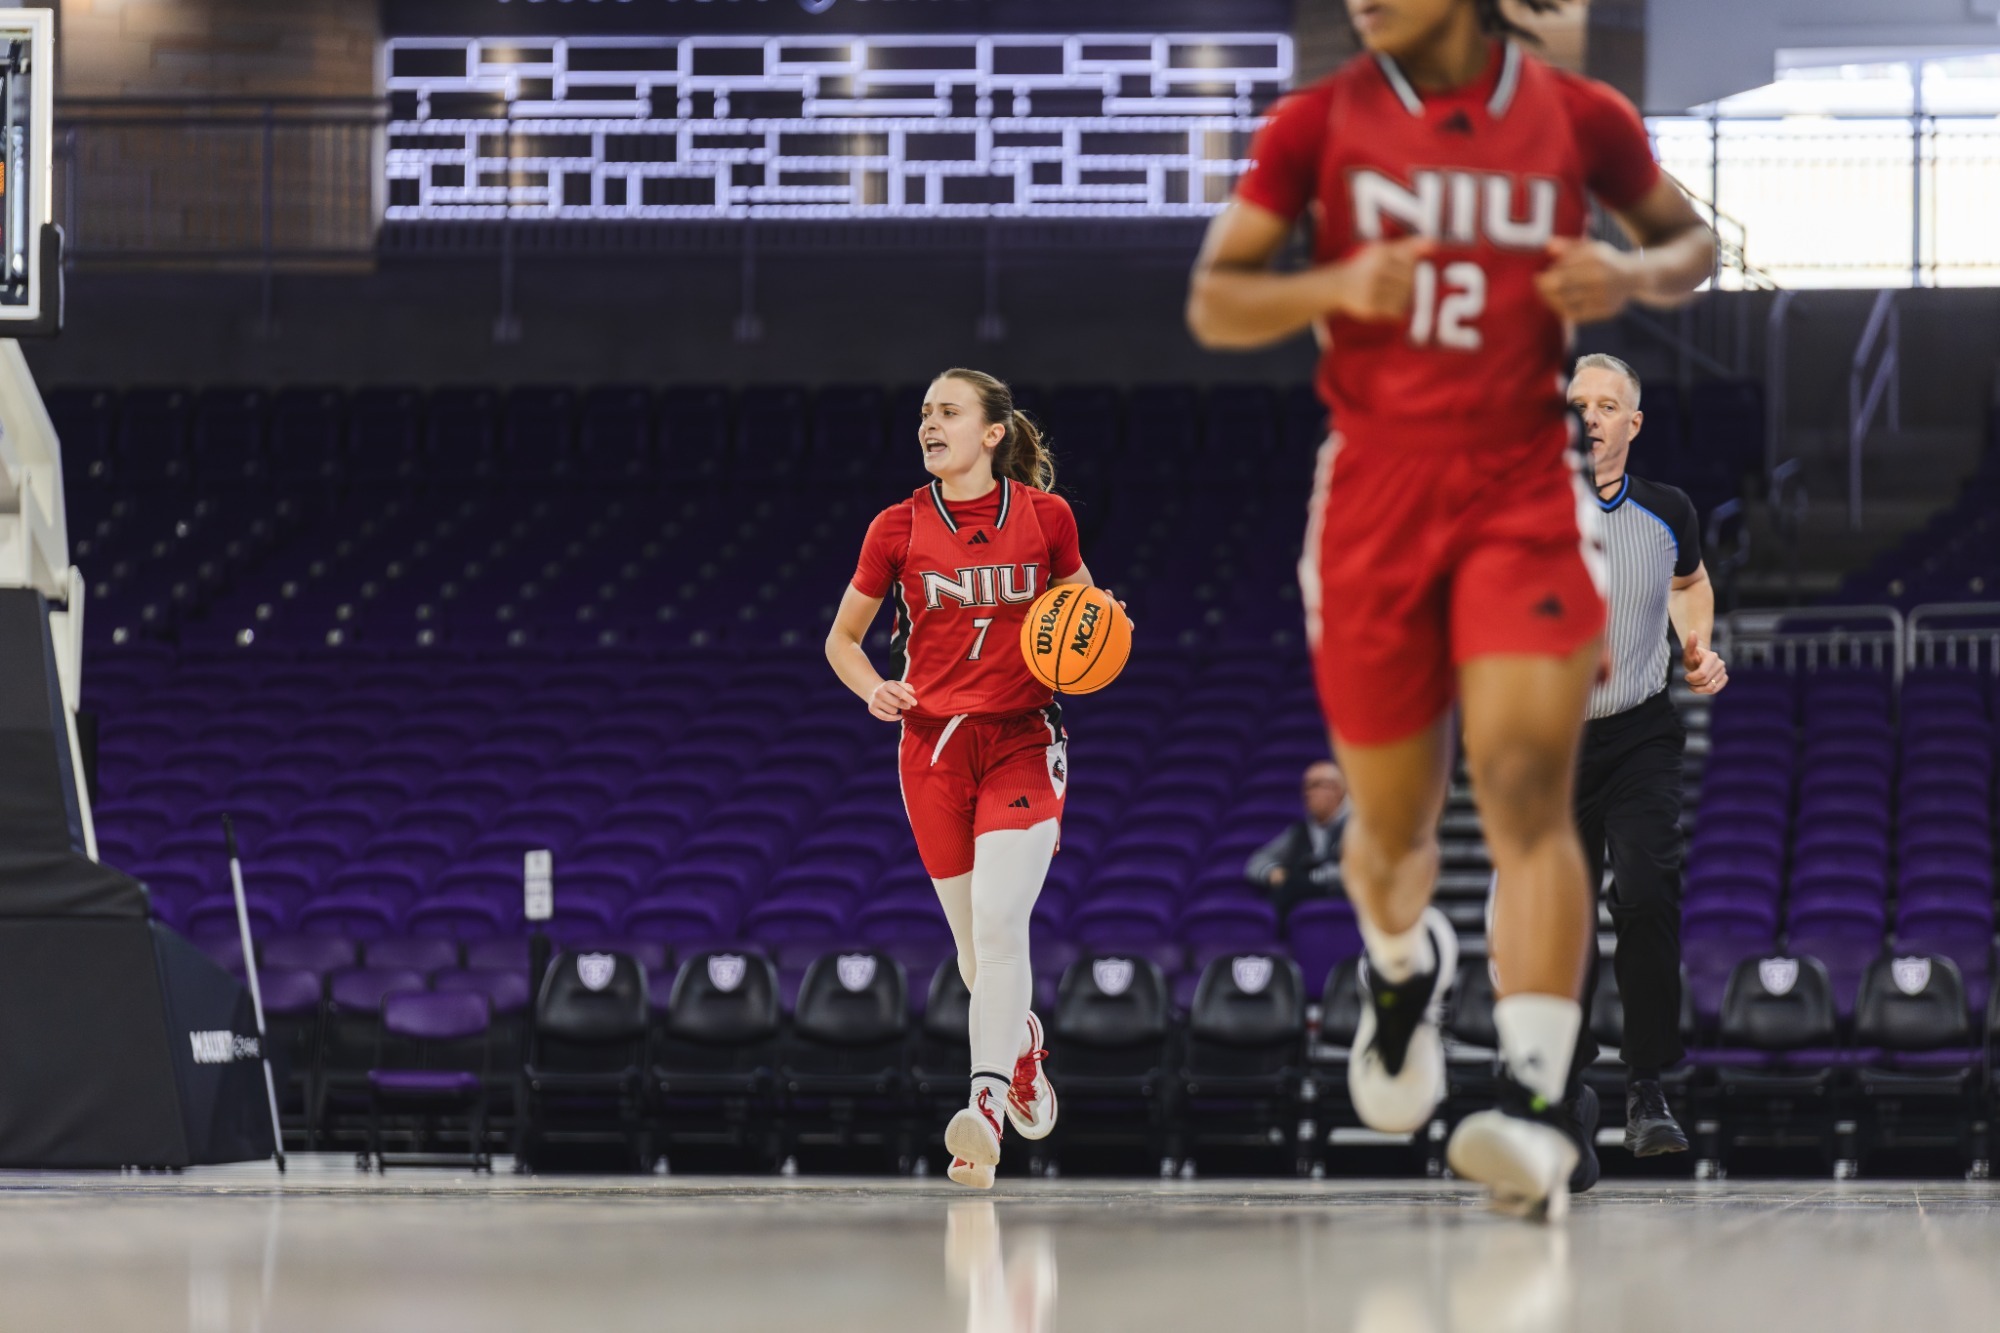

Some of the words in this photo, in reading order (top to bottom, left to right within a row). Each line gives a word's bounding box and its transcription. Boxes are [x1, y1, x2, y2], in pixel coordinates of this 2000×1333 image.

[1351, 168, 1557, 249] NIU
[1410, 260, 1486, 349] 12
[919, 563, 1039, 609] NIU
[966, 618, 994, 661] 7
[1037, 590, 1074, 655] Wilson
[1070, 602, 1101, 656] NCAA
